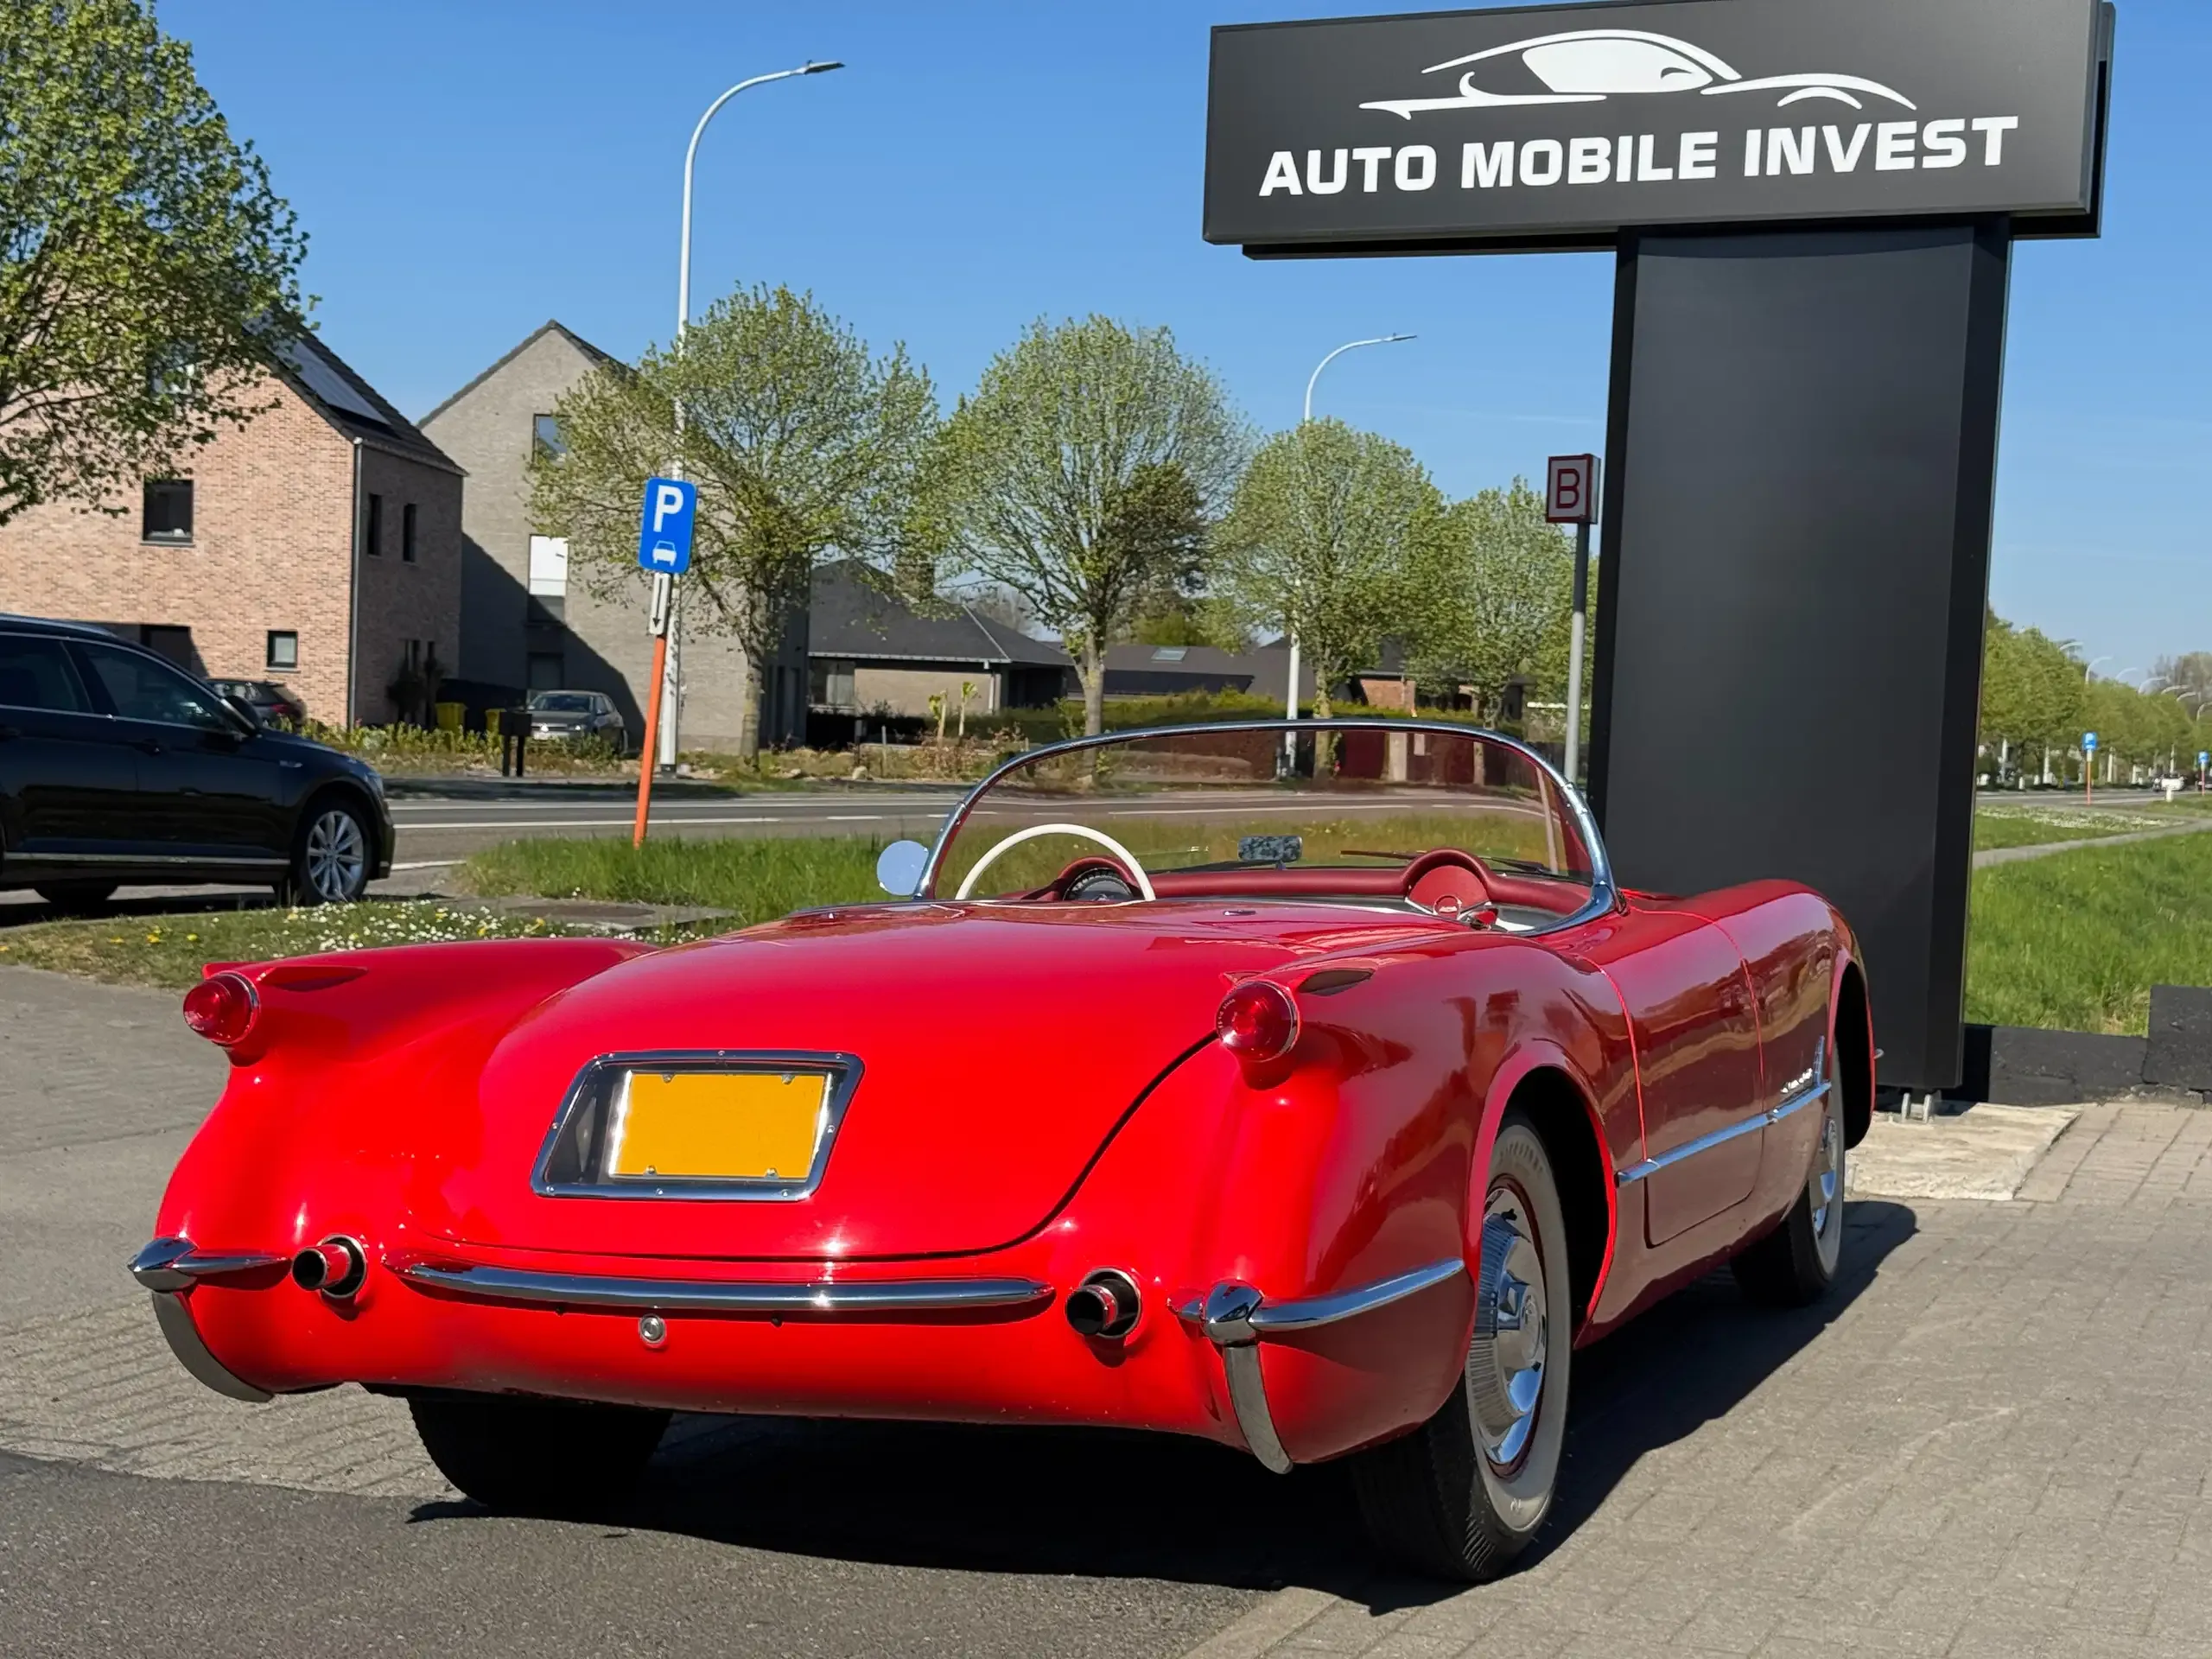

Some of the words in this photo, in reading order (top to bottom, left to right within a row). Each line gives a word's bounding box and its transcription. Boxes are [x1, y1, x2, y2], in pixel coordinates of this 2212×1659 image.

[1258, 144, 1437, 197] AUTO
[1460, 130, 1719, 189] MOBILE
[1744, 115, 2019, 177] INVEST
[653, 485, 683, 532] P
[1556, 468, 1580, 509] B
